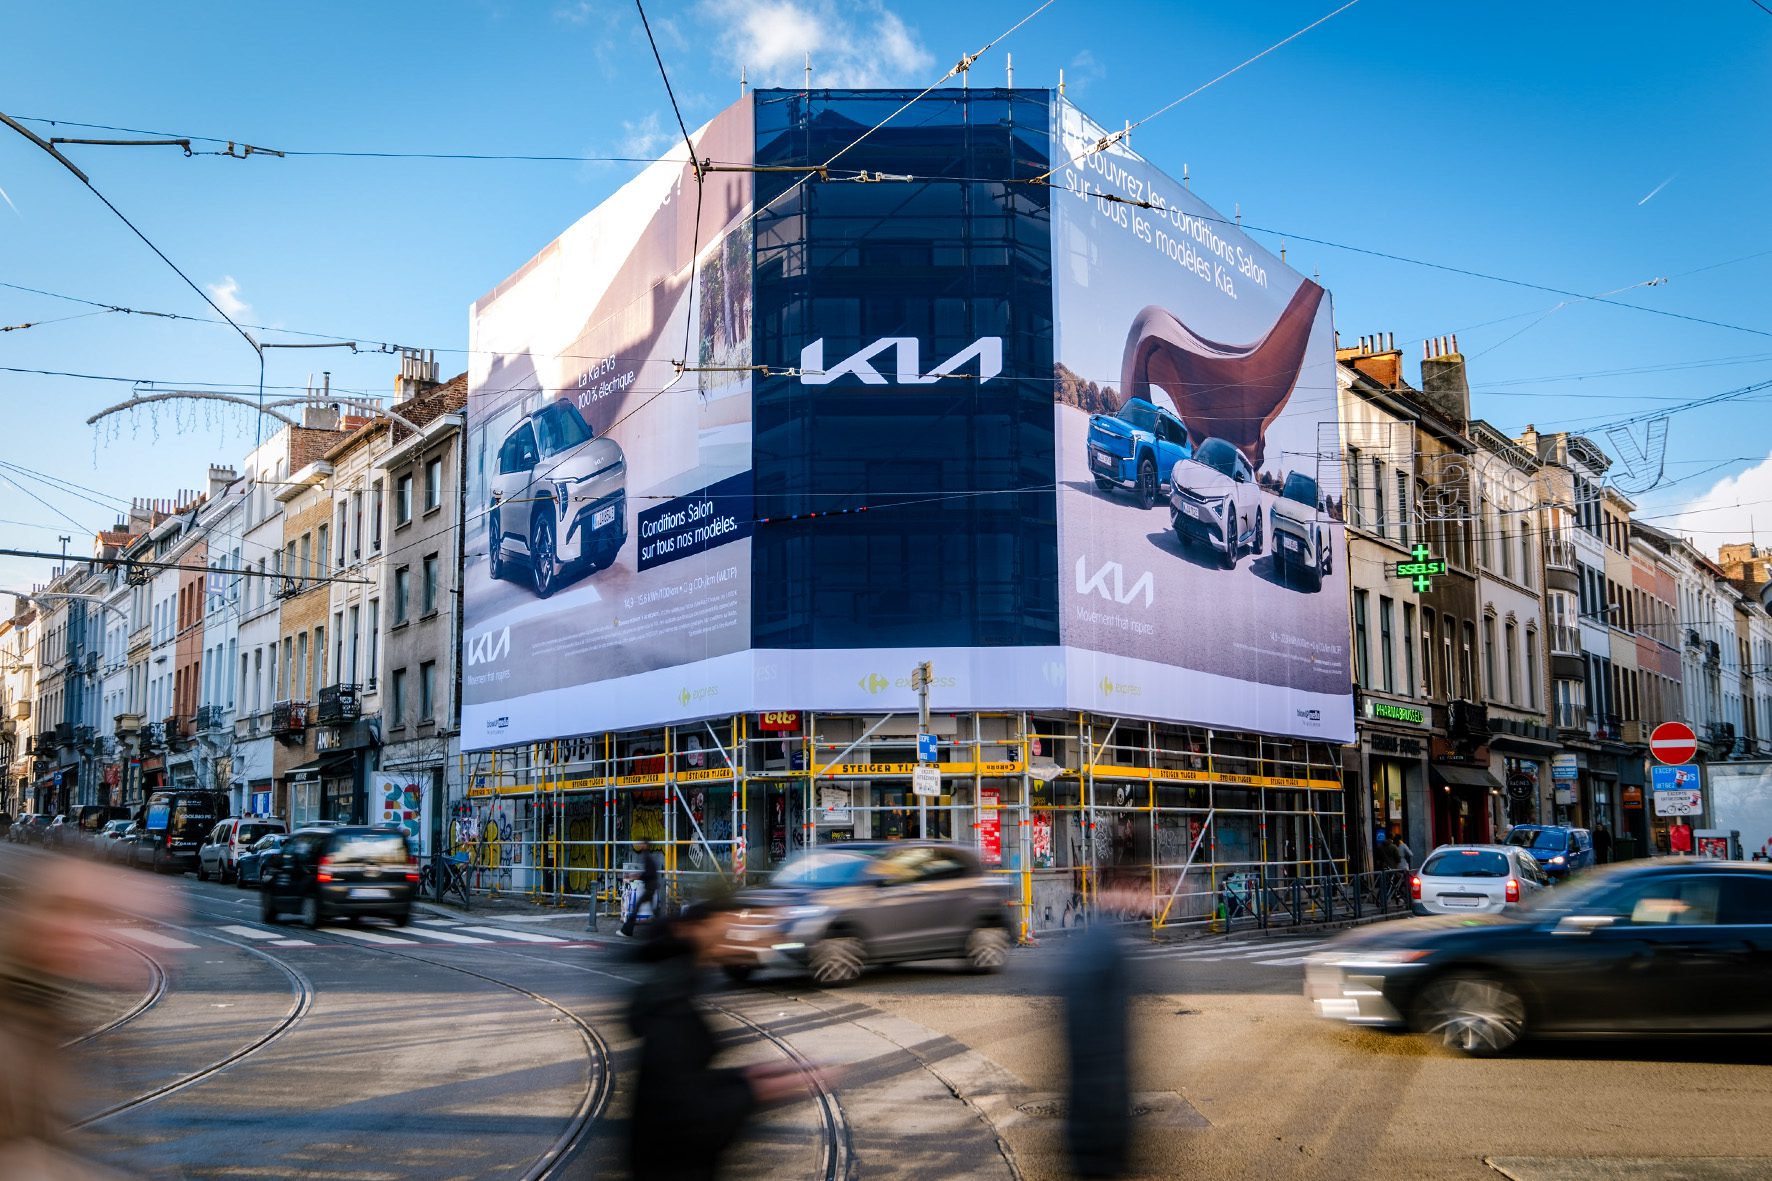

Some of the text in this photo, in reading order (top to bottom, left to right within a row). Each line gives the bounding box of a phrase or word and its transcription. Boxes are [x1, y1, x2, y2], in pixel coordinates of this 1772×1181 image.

[1065, 168, 1238, 300] sur tous les modèles Kia.
[1147, 180, 1167, 219] les
[1169, 205, 1235, 266] conditions
[1236, 246, 1268, 289] Salon
[578, 353, 616, 388] La Kia EV3
[800, 336, 1003, 385] KIA
[598, 370, 636, 399] électrique.
[641, 510, 686, 538] Conditions
[687, 500, 713, 523] Salon
[641, 515, 738, 561] sur tous nos modèles.
[1075, 554, 1154, 609] KIA
[467, 625, 511, 667] KIA
[688, 770, 710, 780] STEIGER
[842, 763, 891, 773] STEIGER
